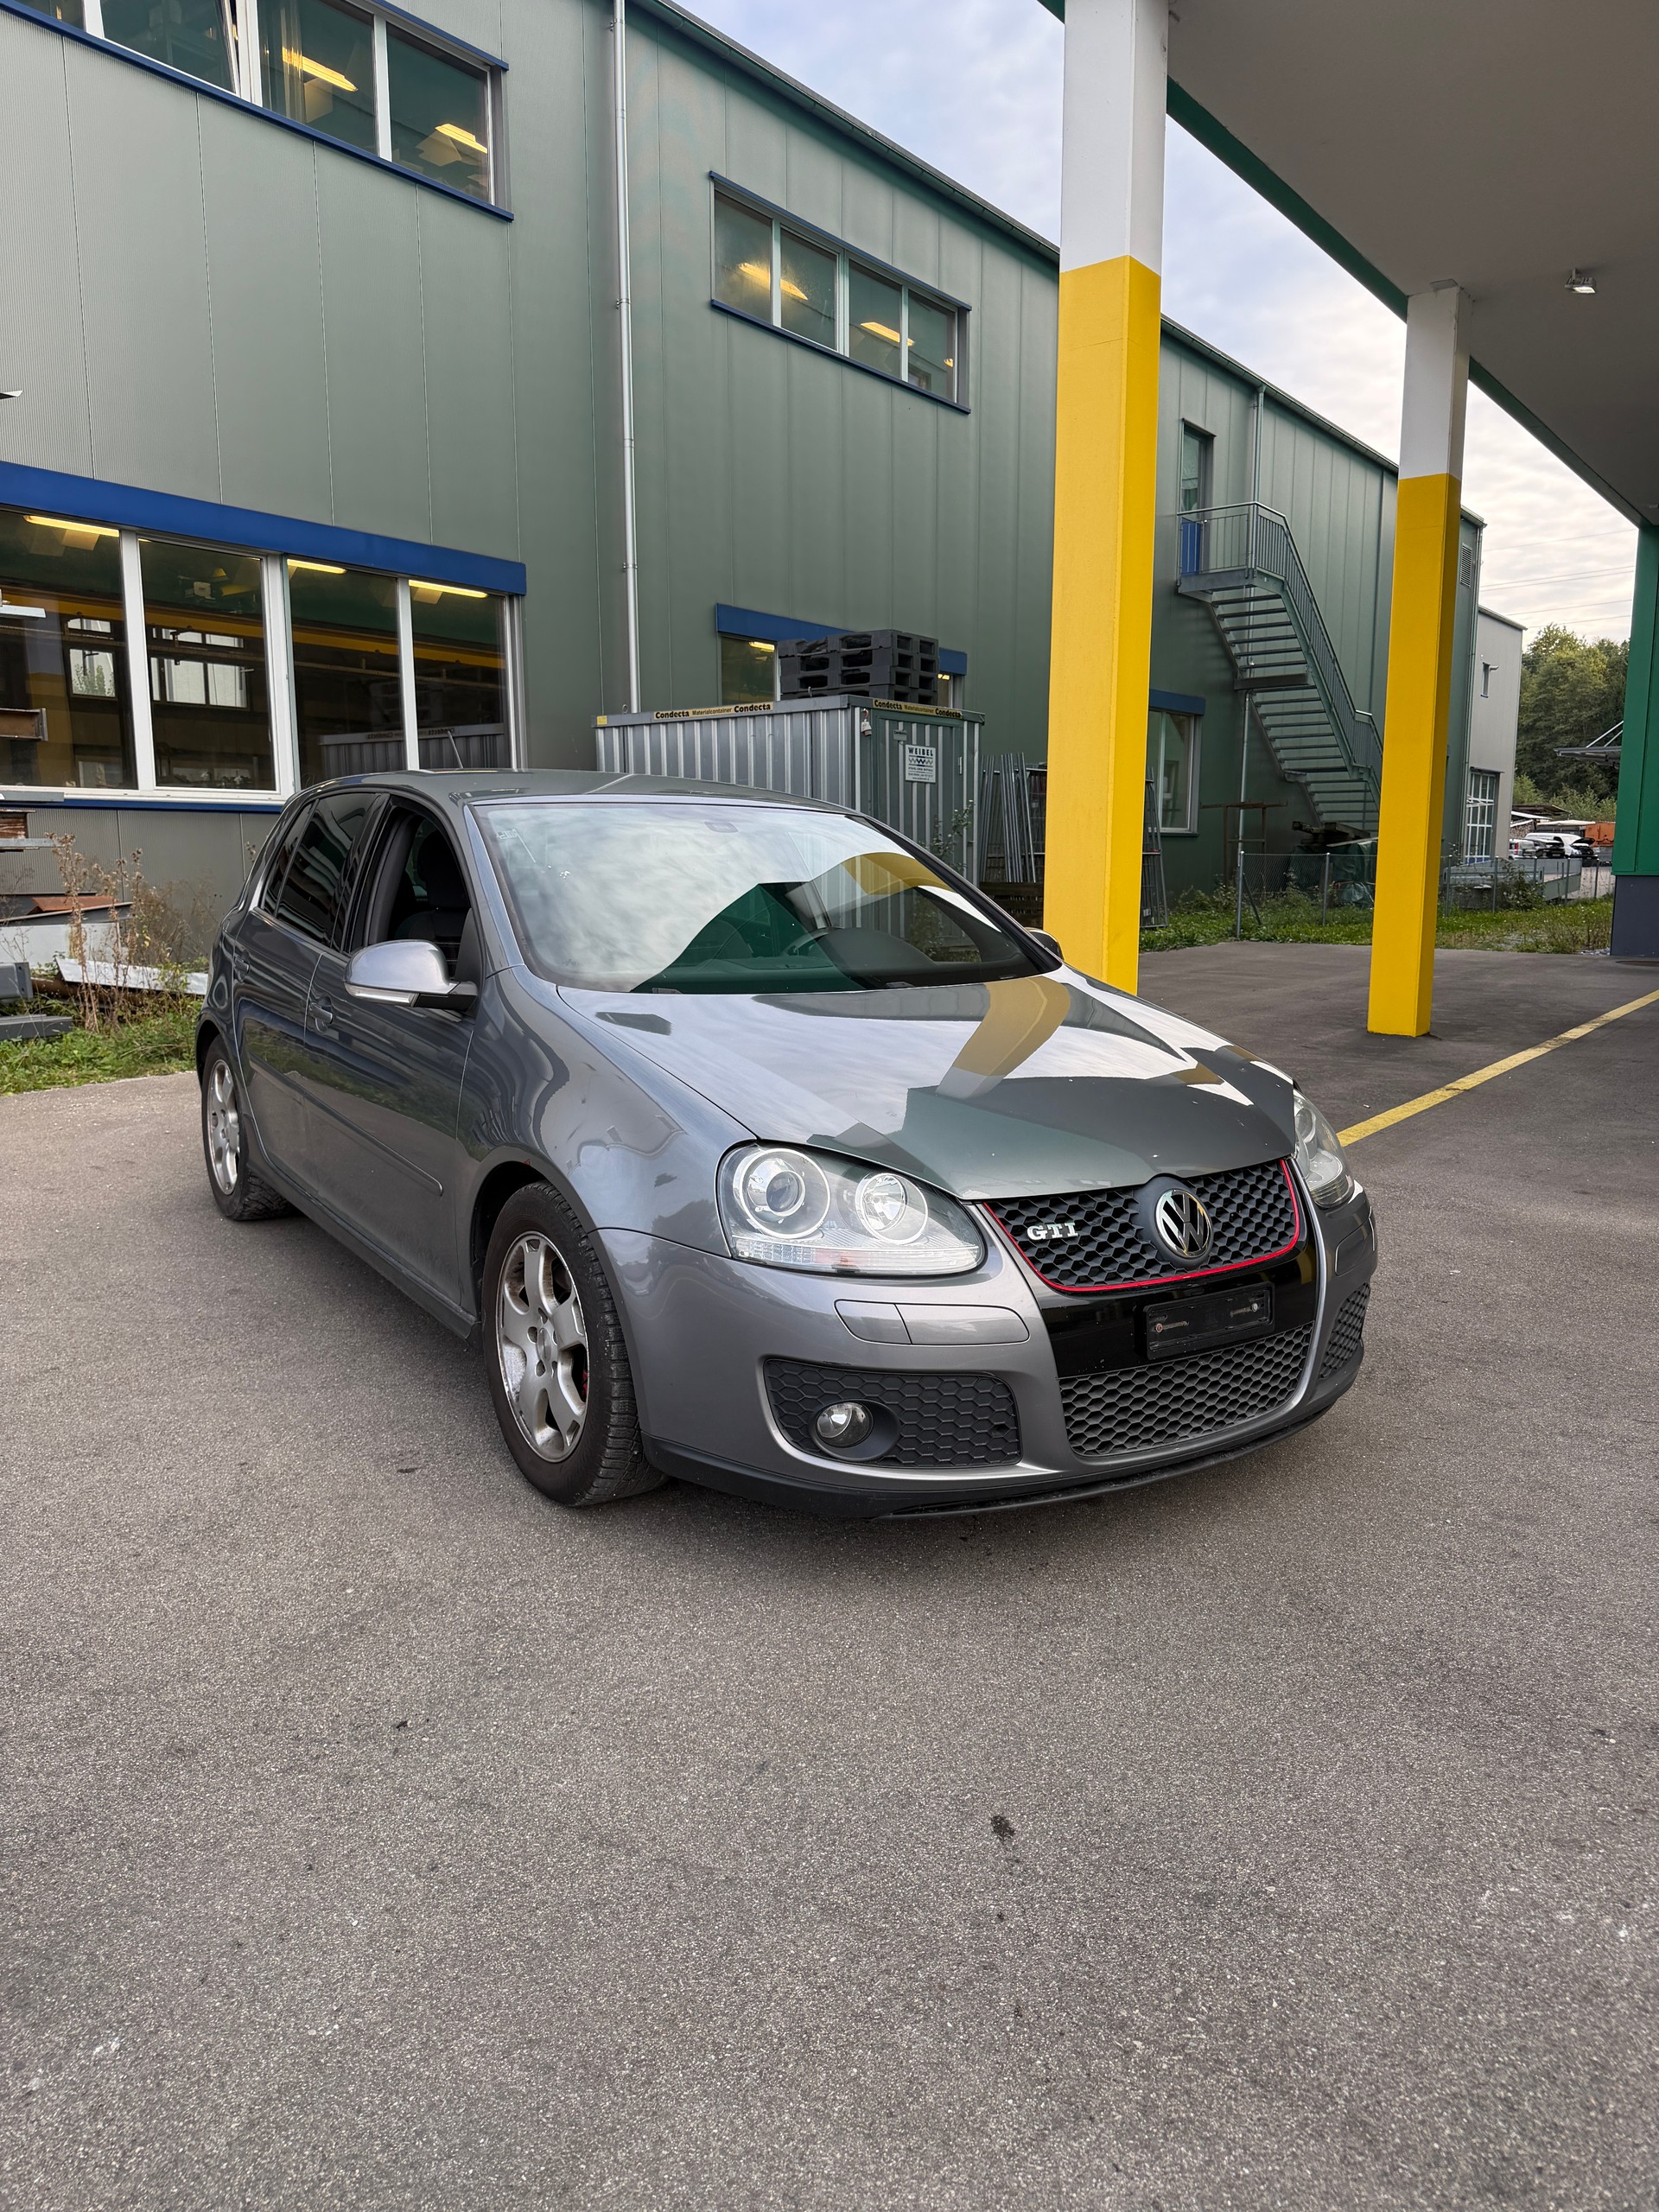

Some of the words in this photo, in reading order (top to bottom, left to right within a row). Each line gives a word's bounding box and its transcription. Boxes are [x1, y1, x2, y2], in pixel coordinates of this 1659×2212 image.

[655, 710, 690, 719] Condecta
[734, 703, 771, 713] Condecta
[874, 699, 903, 710] Condecta
[935, 708, 962, 718] Condecta
[908, 747, 933, 757] WEIBEL
[1027, 1222, 1078, 1241] GTI
